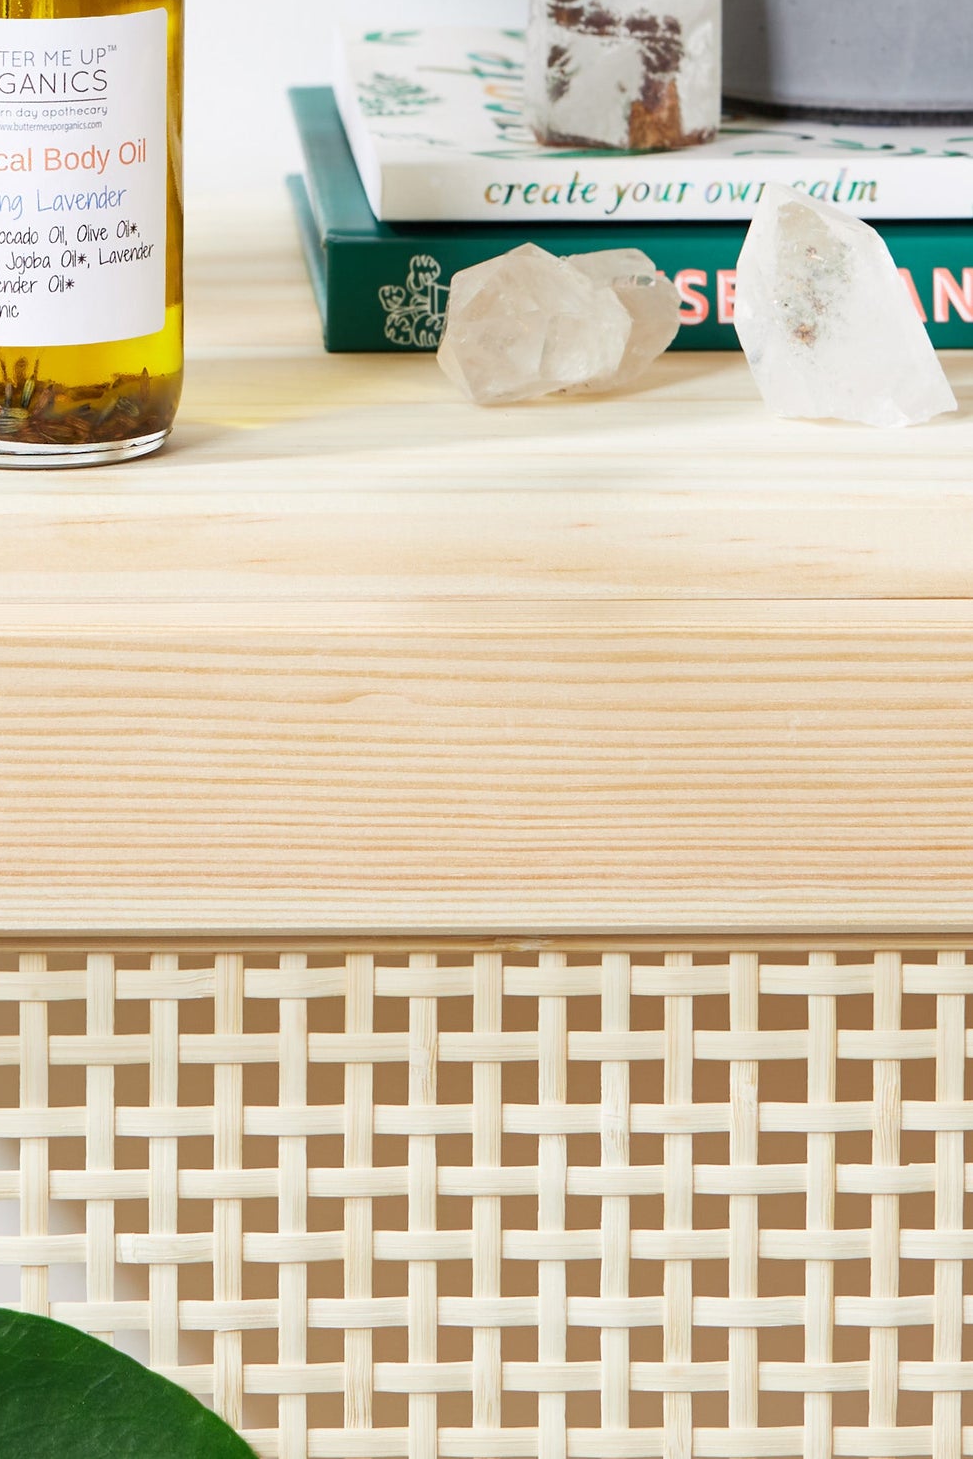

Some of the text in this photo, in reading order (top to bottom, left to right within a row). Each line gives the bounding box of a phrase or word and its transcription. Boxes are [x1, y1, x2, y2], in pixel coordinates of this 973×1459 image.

[44, 49, 72, 67] ME
[15, 107, 38, 120] day
[42, 105, 108, 120] apothecary
[44, 144, 111, 175] Body
[118, 138, 147, 166] Oil
[37, 185, 128, 213] Lavender
[483, 170, 600, 206] create
[604, 180, 695, 215] your
[49, 225, 68, 246] Oil,
[77, 224, 109, 243] Olive
[5, 251, 51, 275] Jojoba
[99, 241, 155, 266] Lavender
